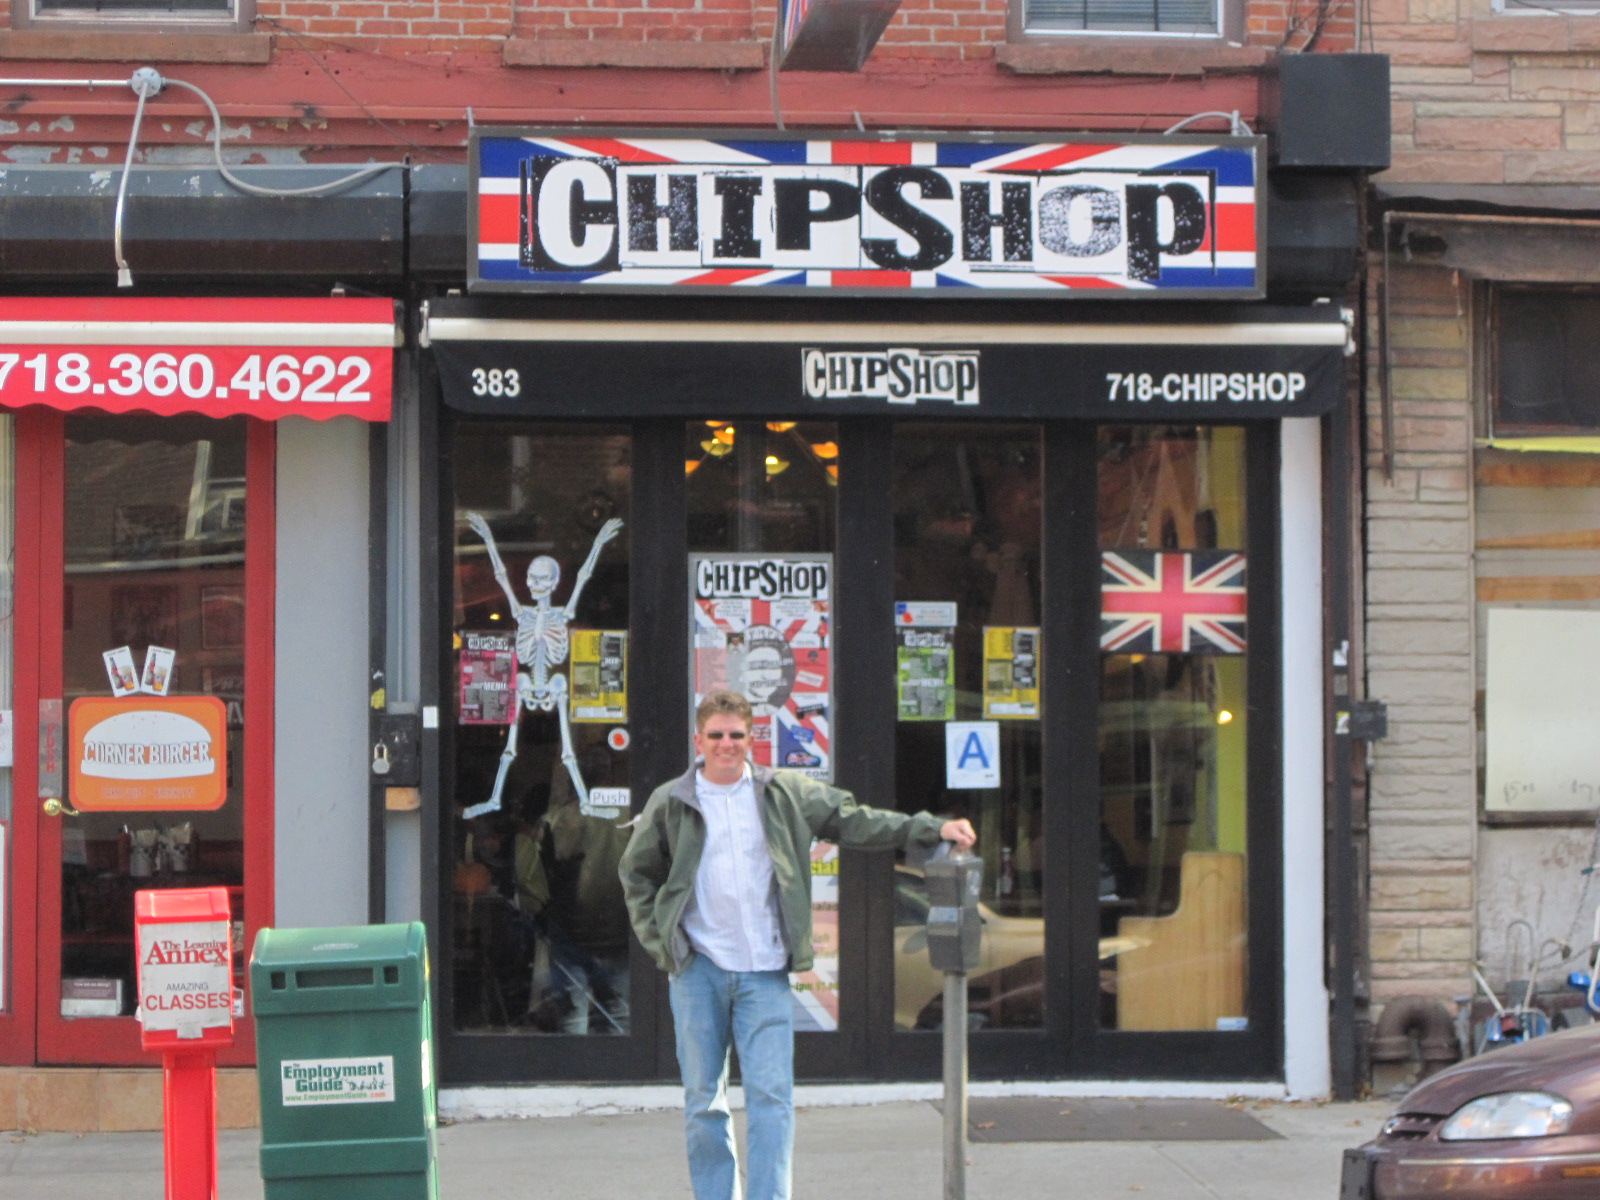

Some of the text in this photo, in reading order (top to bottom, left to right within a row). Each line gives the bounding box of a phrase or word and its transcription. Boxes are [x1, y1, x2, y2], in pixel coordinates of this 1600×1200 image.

[0, 353, 371, 402] 718.360.4622
[472, 368, 520, 397] 383
[1106, 372, 1306, 402] 718-CHIPSHOP
[85, 742, 210, 764] CORNER BURGER
[957, 731, 990, 769] A
[593, 791, 626, 804] Push
[144, 941, 228, 966] Annex
[162, 940, 180, 950] The
[166, 982, 209, 992] AMAZING
[145, 992, 230, 1012] CLASSES
[283, 1062, 384, 1080] Employment
[295, 1078, 343, 1093] Guide
